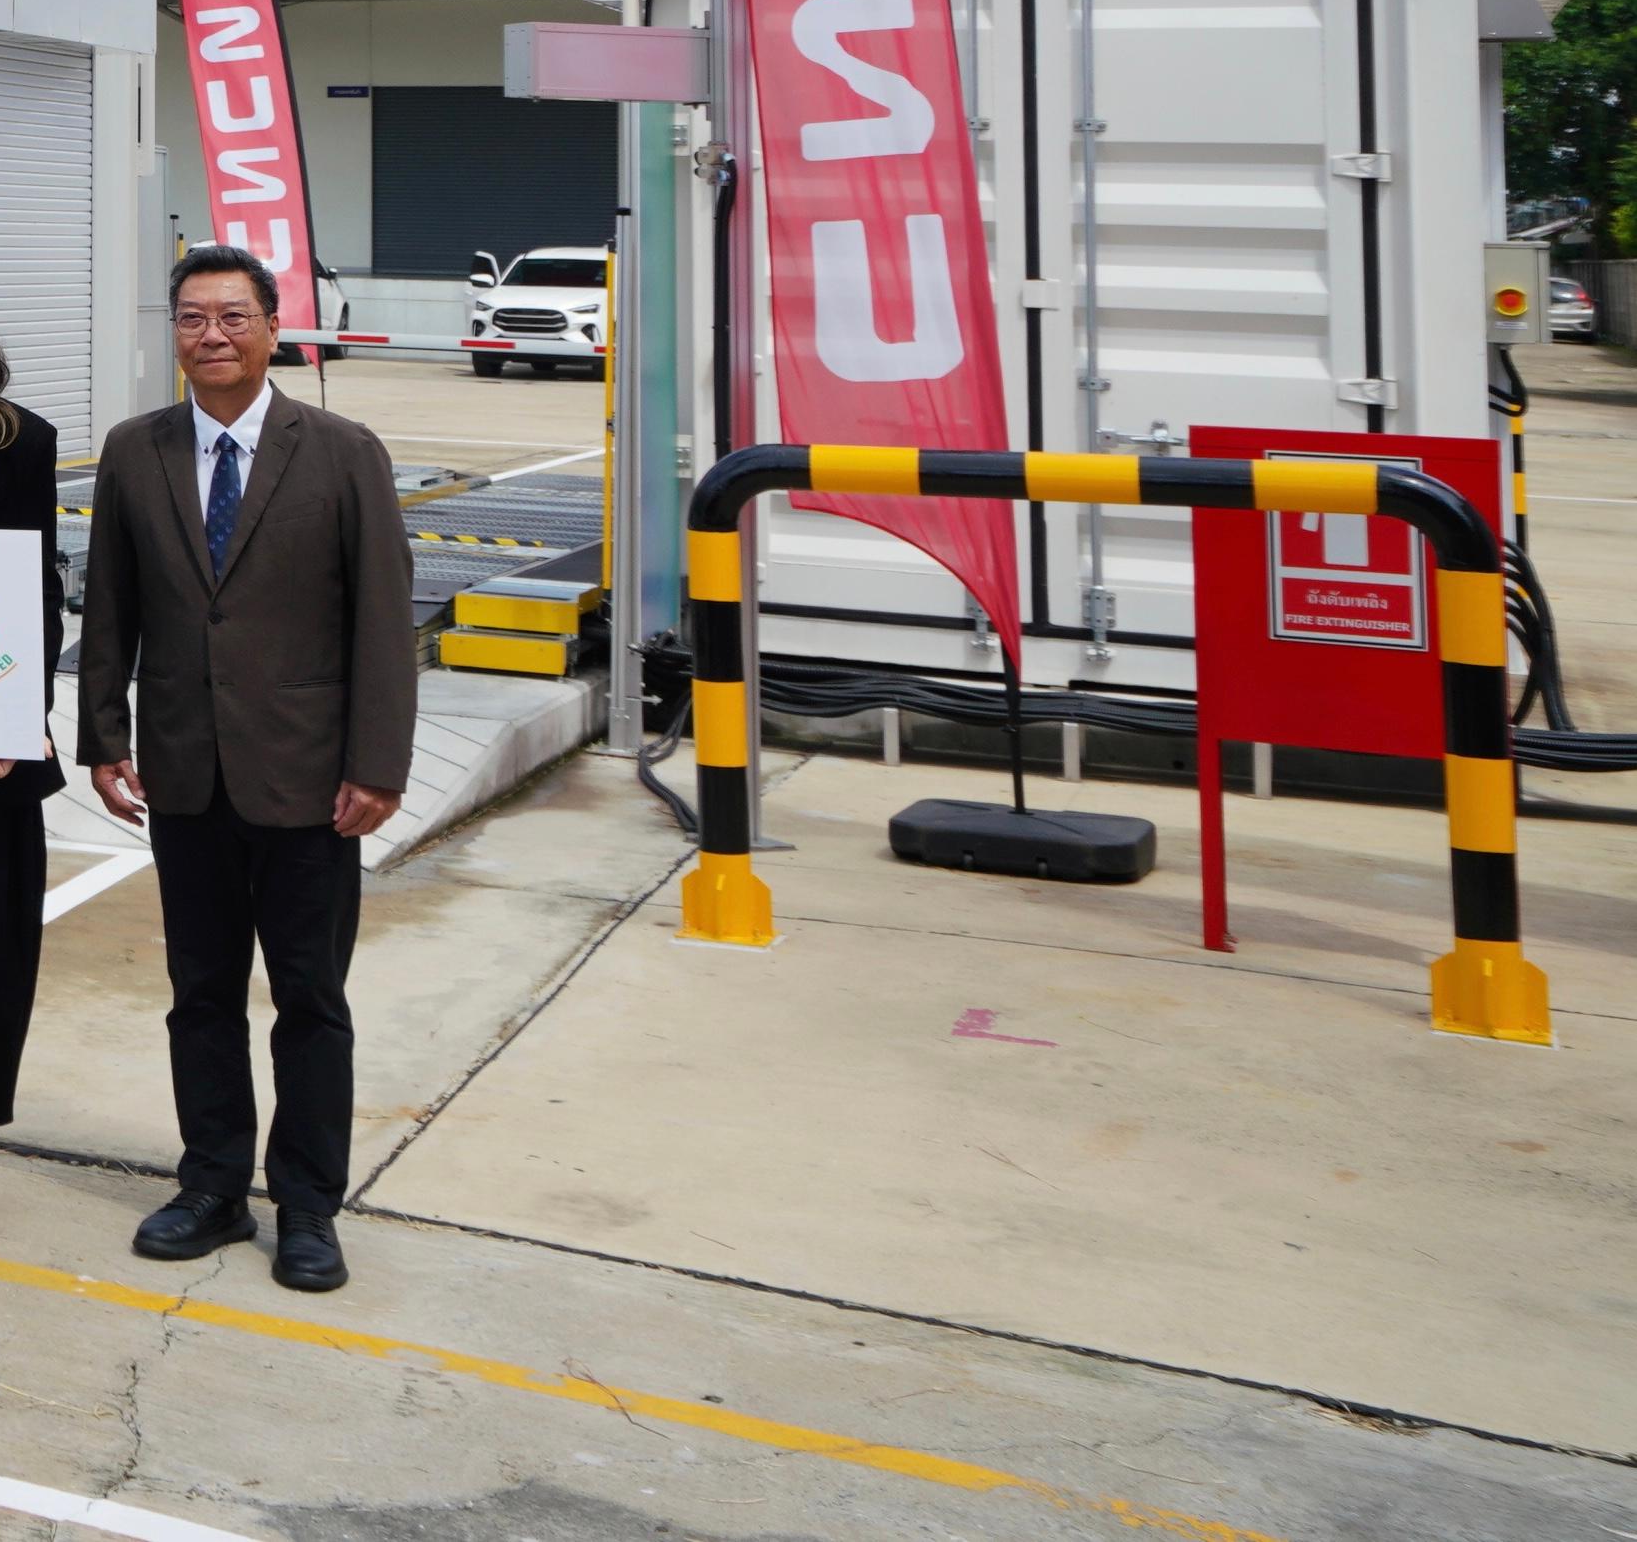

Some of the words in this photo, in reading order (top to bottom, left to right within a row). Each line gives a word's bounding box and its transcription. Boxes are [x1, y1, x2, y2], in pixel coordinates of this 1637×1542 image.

[1307, 588, 1388, 610] ถังดับเพลิง
[1285, 614, 1314, 625] FIRE
[1317, 616, 1411, 632] EXTINGUISHER
